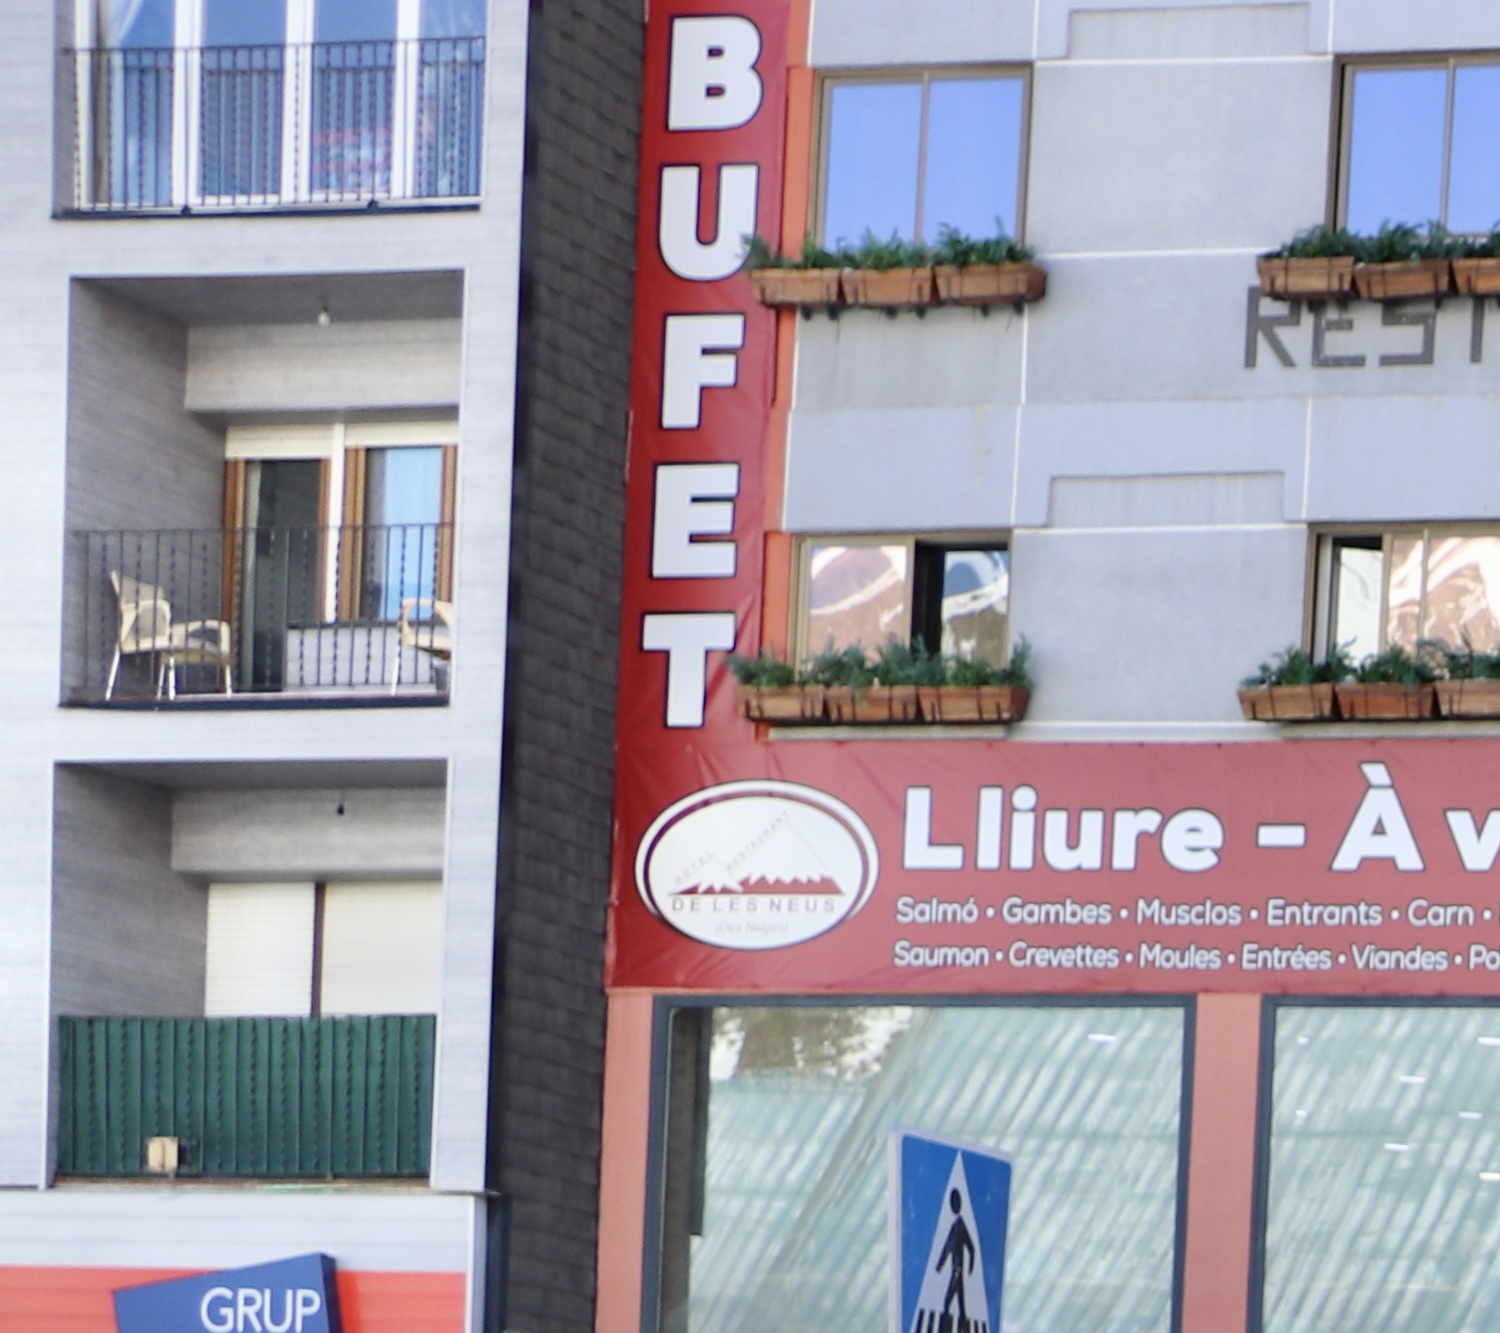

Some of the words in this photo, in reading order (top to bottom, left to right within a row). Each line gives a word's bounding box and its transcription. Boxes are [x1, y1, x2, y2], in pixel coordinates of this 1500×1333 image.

[641, 13, 762, 728] BUFET
[902, 784, 1224, 872] Lliure
[1330, 761, 1425, 872] À
[672, 898, 701, 912] DE
[713, 898, 757, 912] LES
[769, 898, 835, 912] NEUS
[896, 897, 978, 926] Salmó
[1003, 897, 1111, 926] Gambes
[1137, 897, 1242, 926] Musclos
[1266, 897, 1382, 926] Entrants
[1407, 898, 1474, 926] Carn
[893, 939, 989, 968] Saumon
[1009, 939, 1119, 968] Crevettes
[1138, 940, 1221, 968] Moules
[1242, 941, 1331, 969] Entrées
[1352, 941, 1448, 969] Viandes
